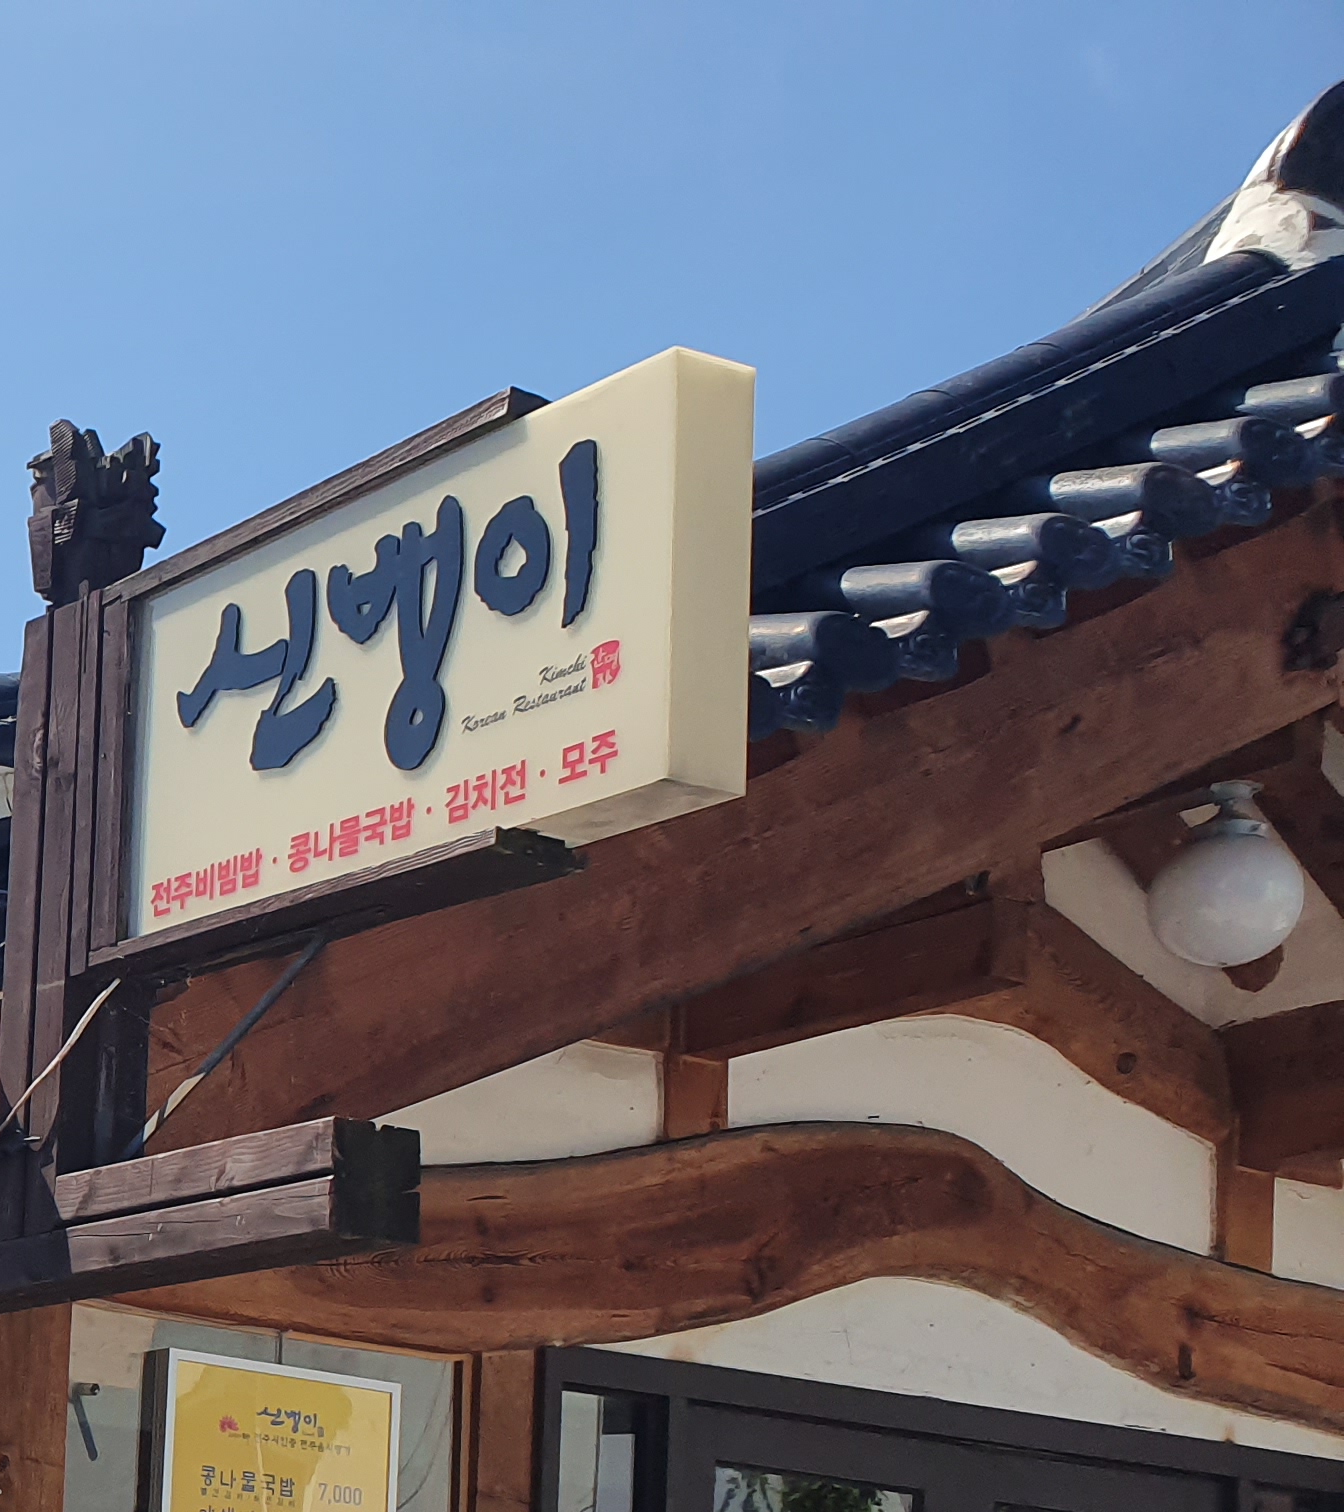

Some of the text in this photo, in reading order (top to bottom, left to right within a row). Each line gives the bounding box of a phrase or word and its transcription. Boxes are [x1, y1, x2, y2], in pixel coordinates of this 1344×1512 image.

[176, 438, 599, 771] 신뱅이
[538, 653, 588, 685] Kimchi
[461, 677, 587, 734] Korean Restaurant
[150, 729, 619, 917] 전주비빔밥 콩나물국밥 김치전 모주
[256, 1406, 318, 1434] 신뱅이
[200, 1465, 363, 1506] 콩나물국밥 7,000
